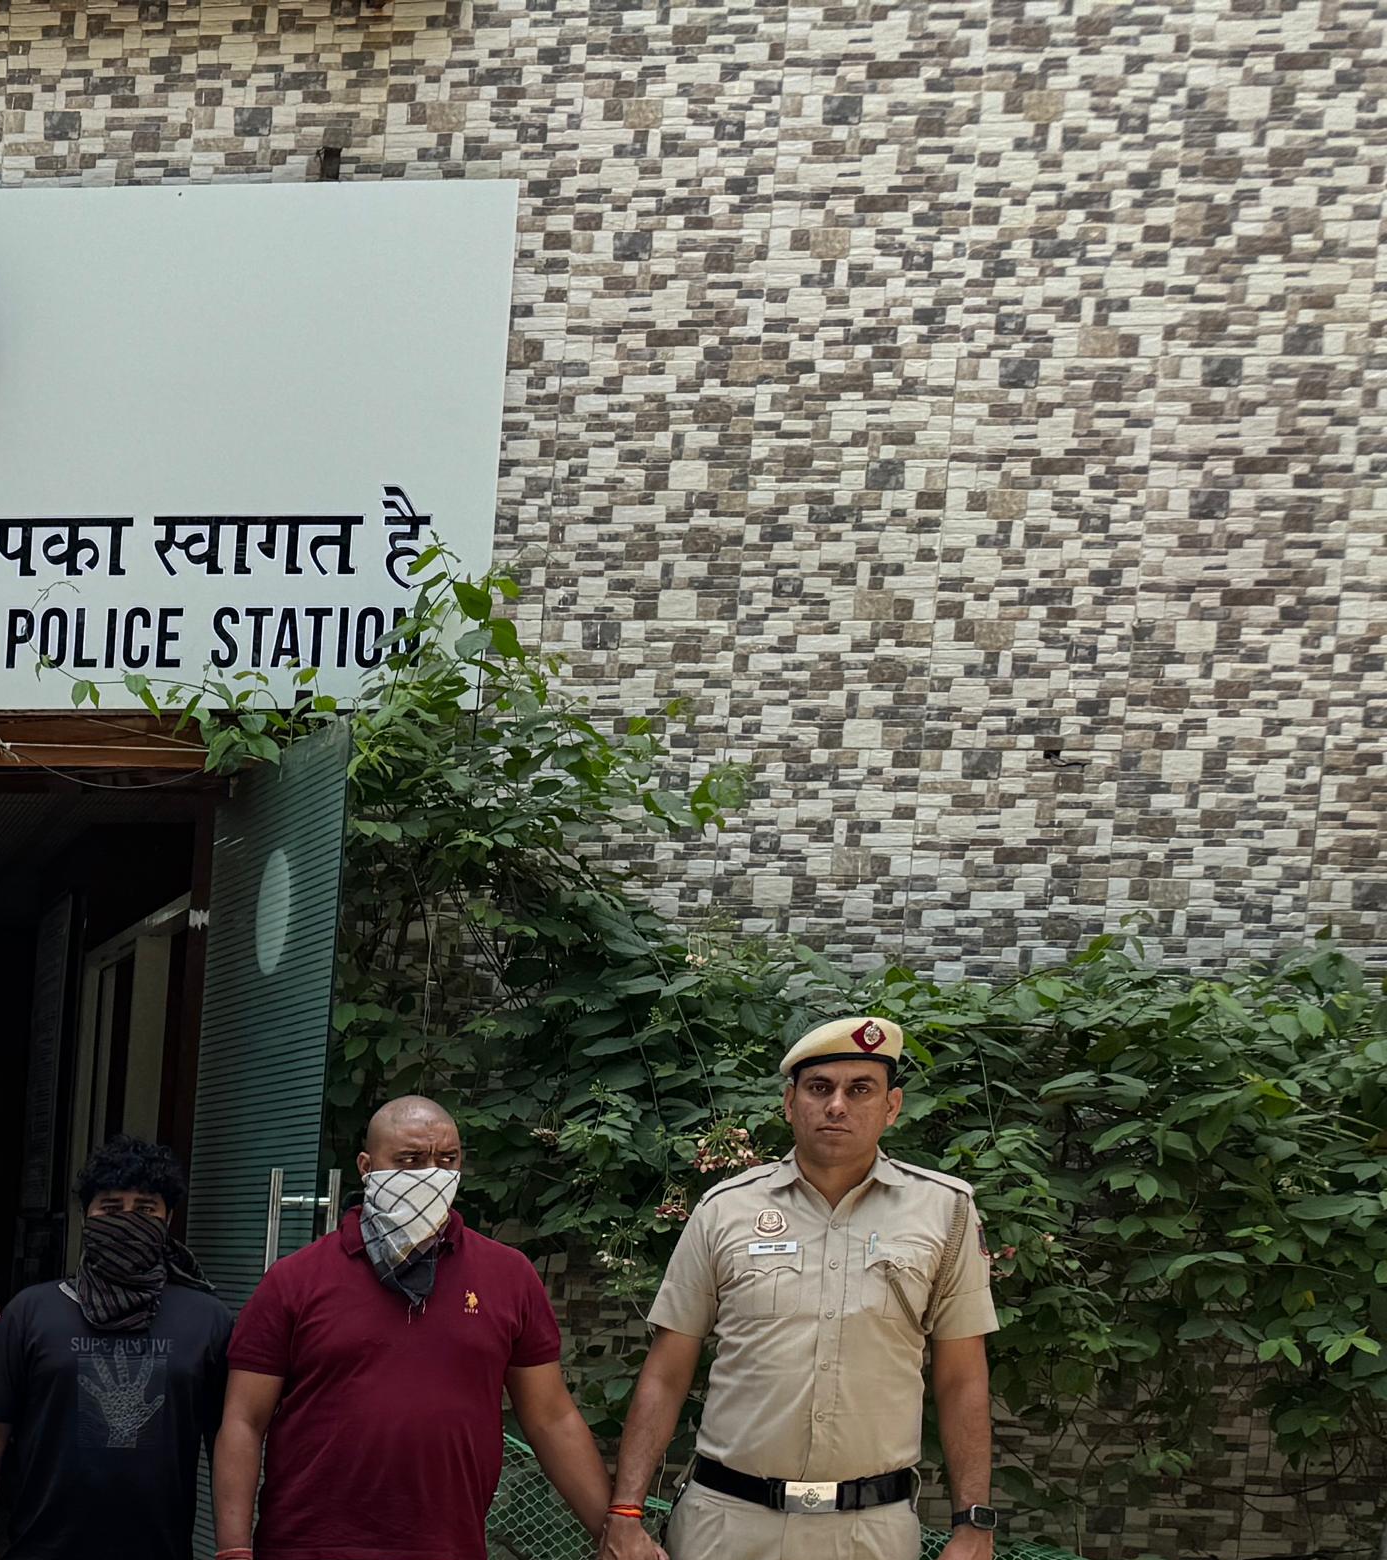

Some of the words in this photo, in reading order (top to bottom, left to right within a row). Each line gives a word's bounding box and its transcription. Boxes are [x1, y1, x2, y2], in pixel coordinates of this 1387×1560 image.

[153, 515, 364, 576] स्वागत
[382, 484, 432, 590] है
[5, 607, 184, 670] POLICE
